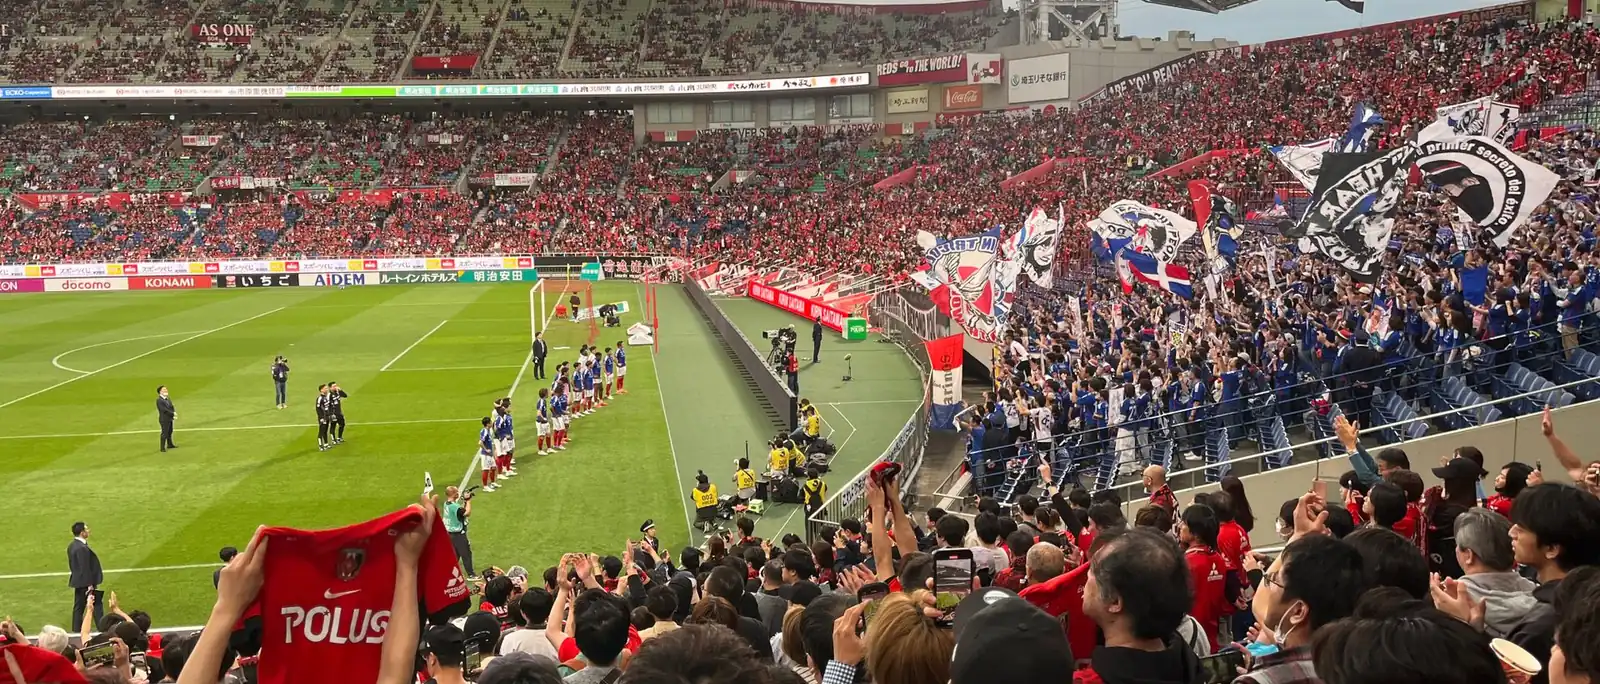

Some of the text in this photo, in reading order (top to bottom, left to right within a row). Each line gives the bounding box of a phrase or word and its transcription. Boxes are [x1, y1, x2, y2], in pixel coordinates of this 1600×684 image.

[199, 23, 254, 37] AS ONE
[877, 62, 898, 76] REDS
[914, 58, 929, 72] THE
[929, 54, 962, 70] WORLD!
[1021, 71, 1067, 85] 埼玉りそな銀行
[1476, 146, 1517, 177] secreto
[1508, 178, 1522, 195] del
[241, 274, 290, 287] いちご
[381, 272, 457, 284] ルートインホテルズ
[473, 270, 523, 282] 明治安田
[62, 280, 111, 290] docomo
[145, 278, 194, 288] KONAMI
[281, 605, 392, 645] POLUS
